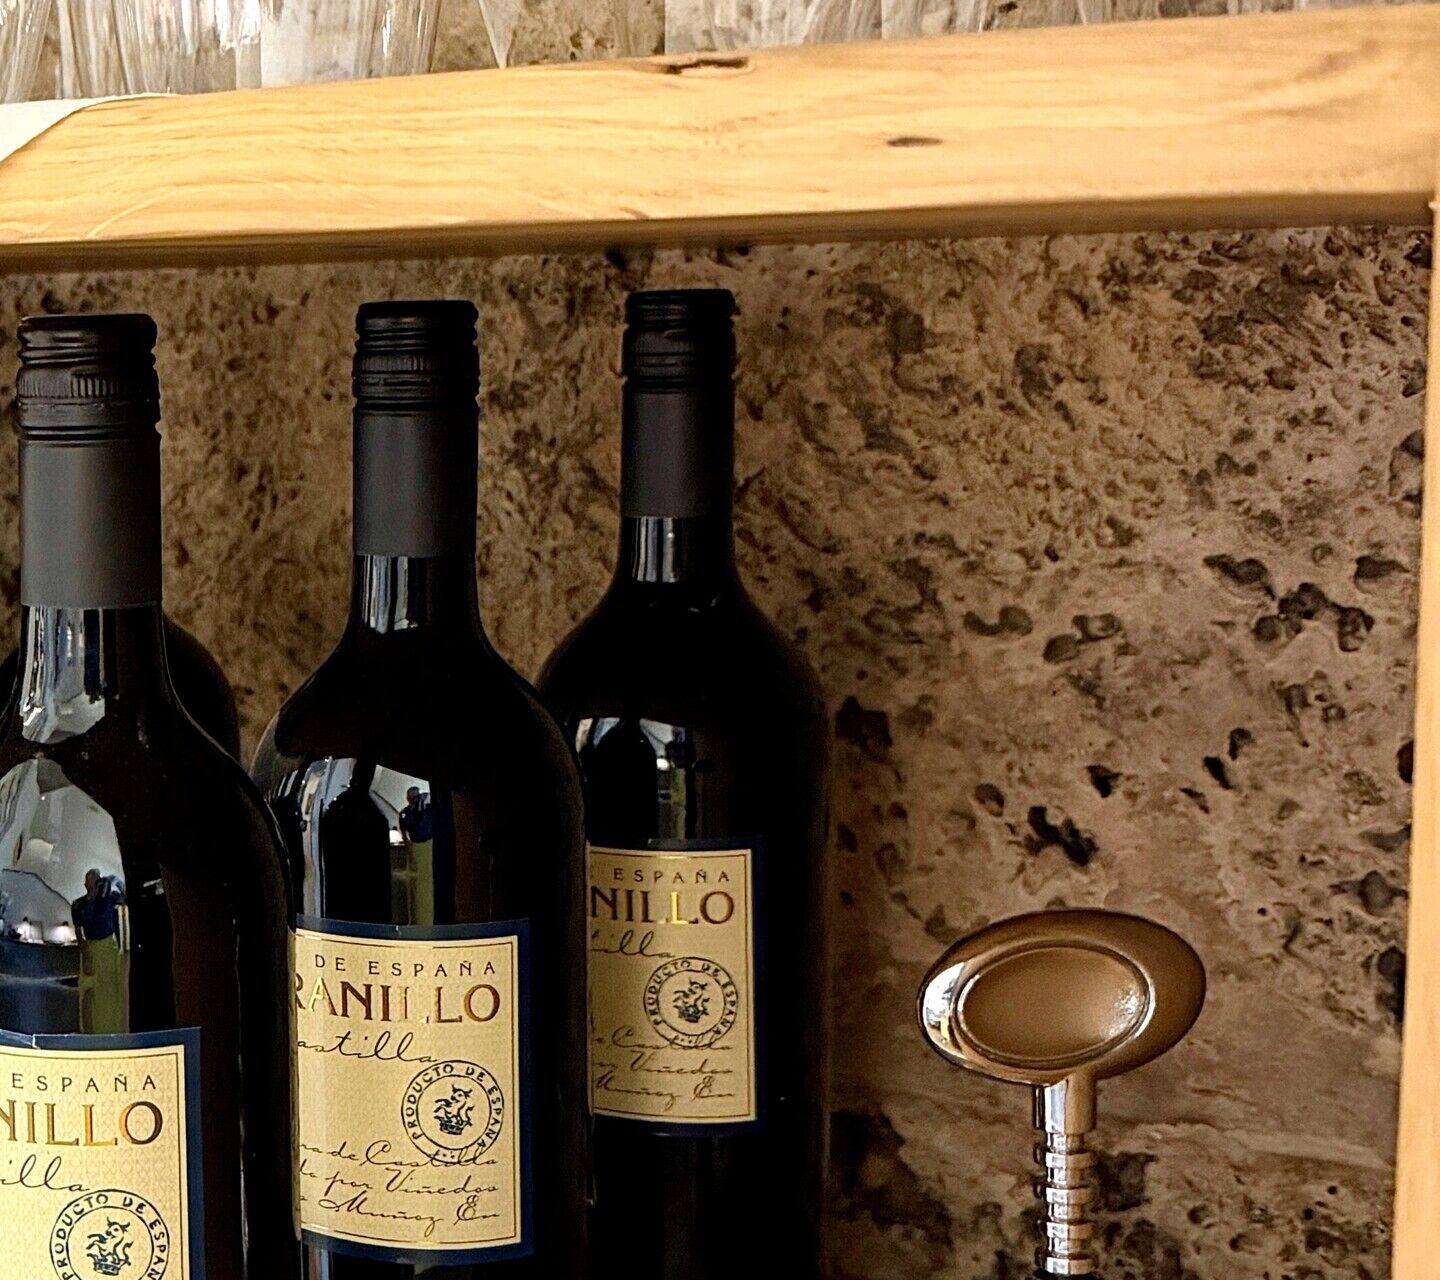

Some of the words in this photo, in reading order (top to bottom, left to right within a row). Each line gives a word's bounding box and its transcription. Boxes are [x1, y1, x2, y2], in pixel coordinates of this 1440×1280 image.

[613, 867, 730, 884] ESPAÑA
[315, 953, 347, 972] DE
[368, 960, 497, 978] ESPAÑA
[11, 1072, 157, 1093] ESPAÑA
[404, 1063, 456, 1141] PRODUCTO
[464, 1065, 488, 1082] DE
[54, 1192, 110, 1280] PRODUCTO
[122, 1196, 147, 1215] DE
